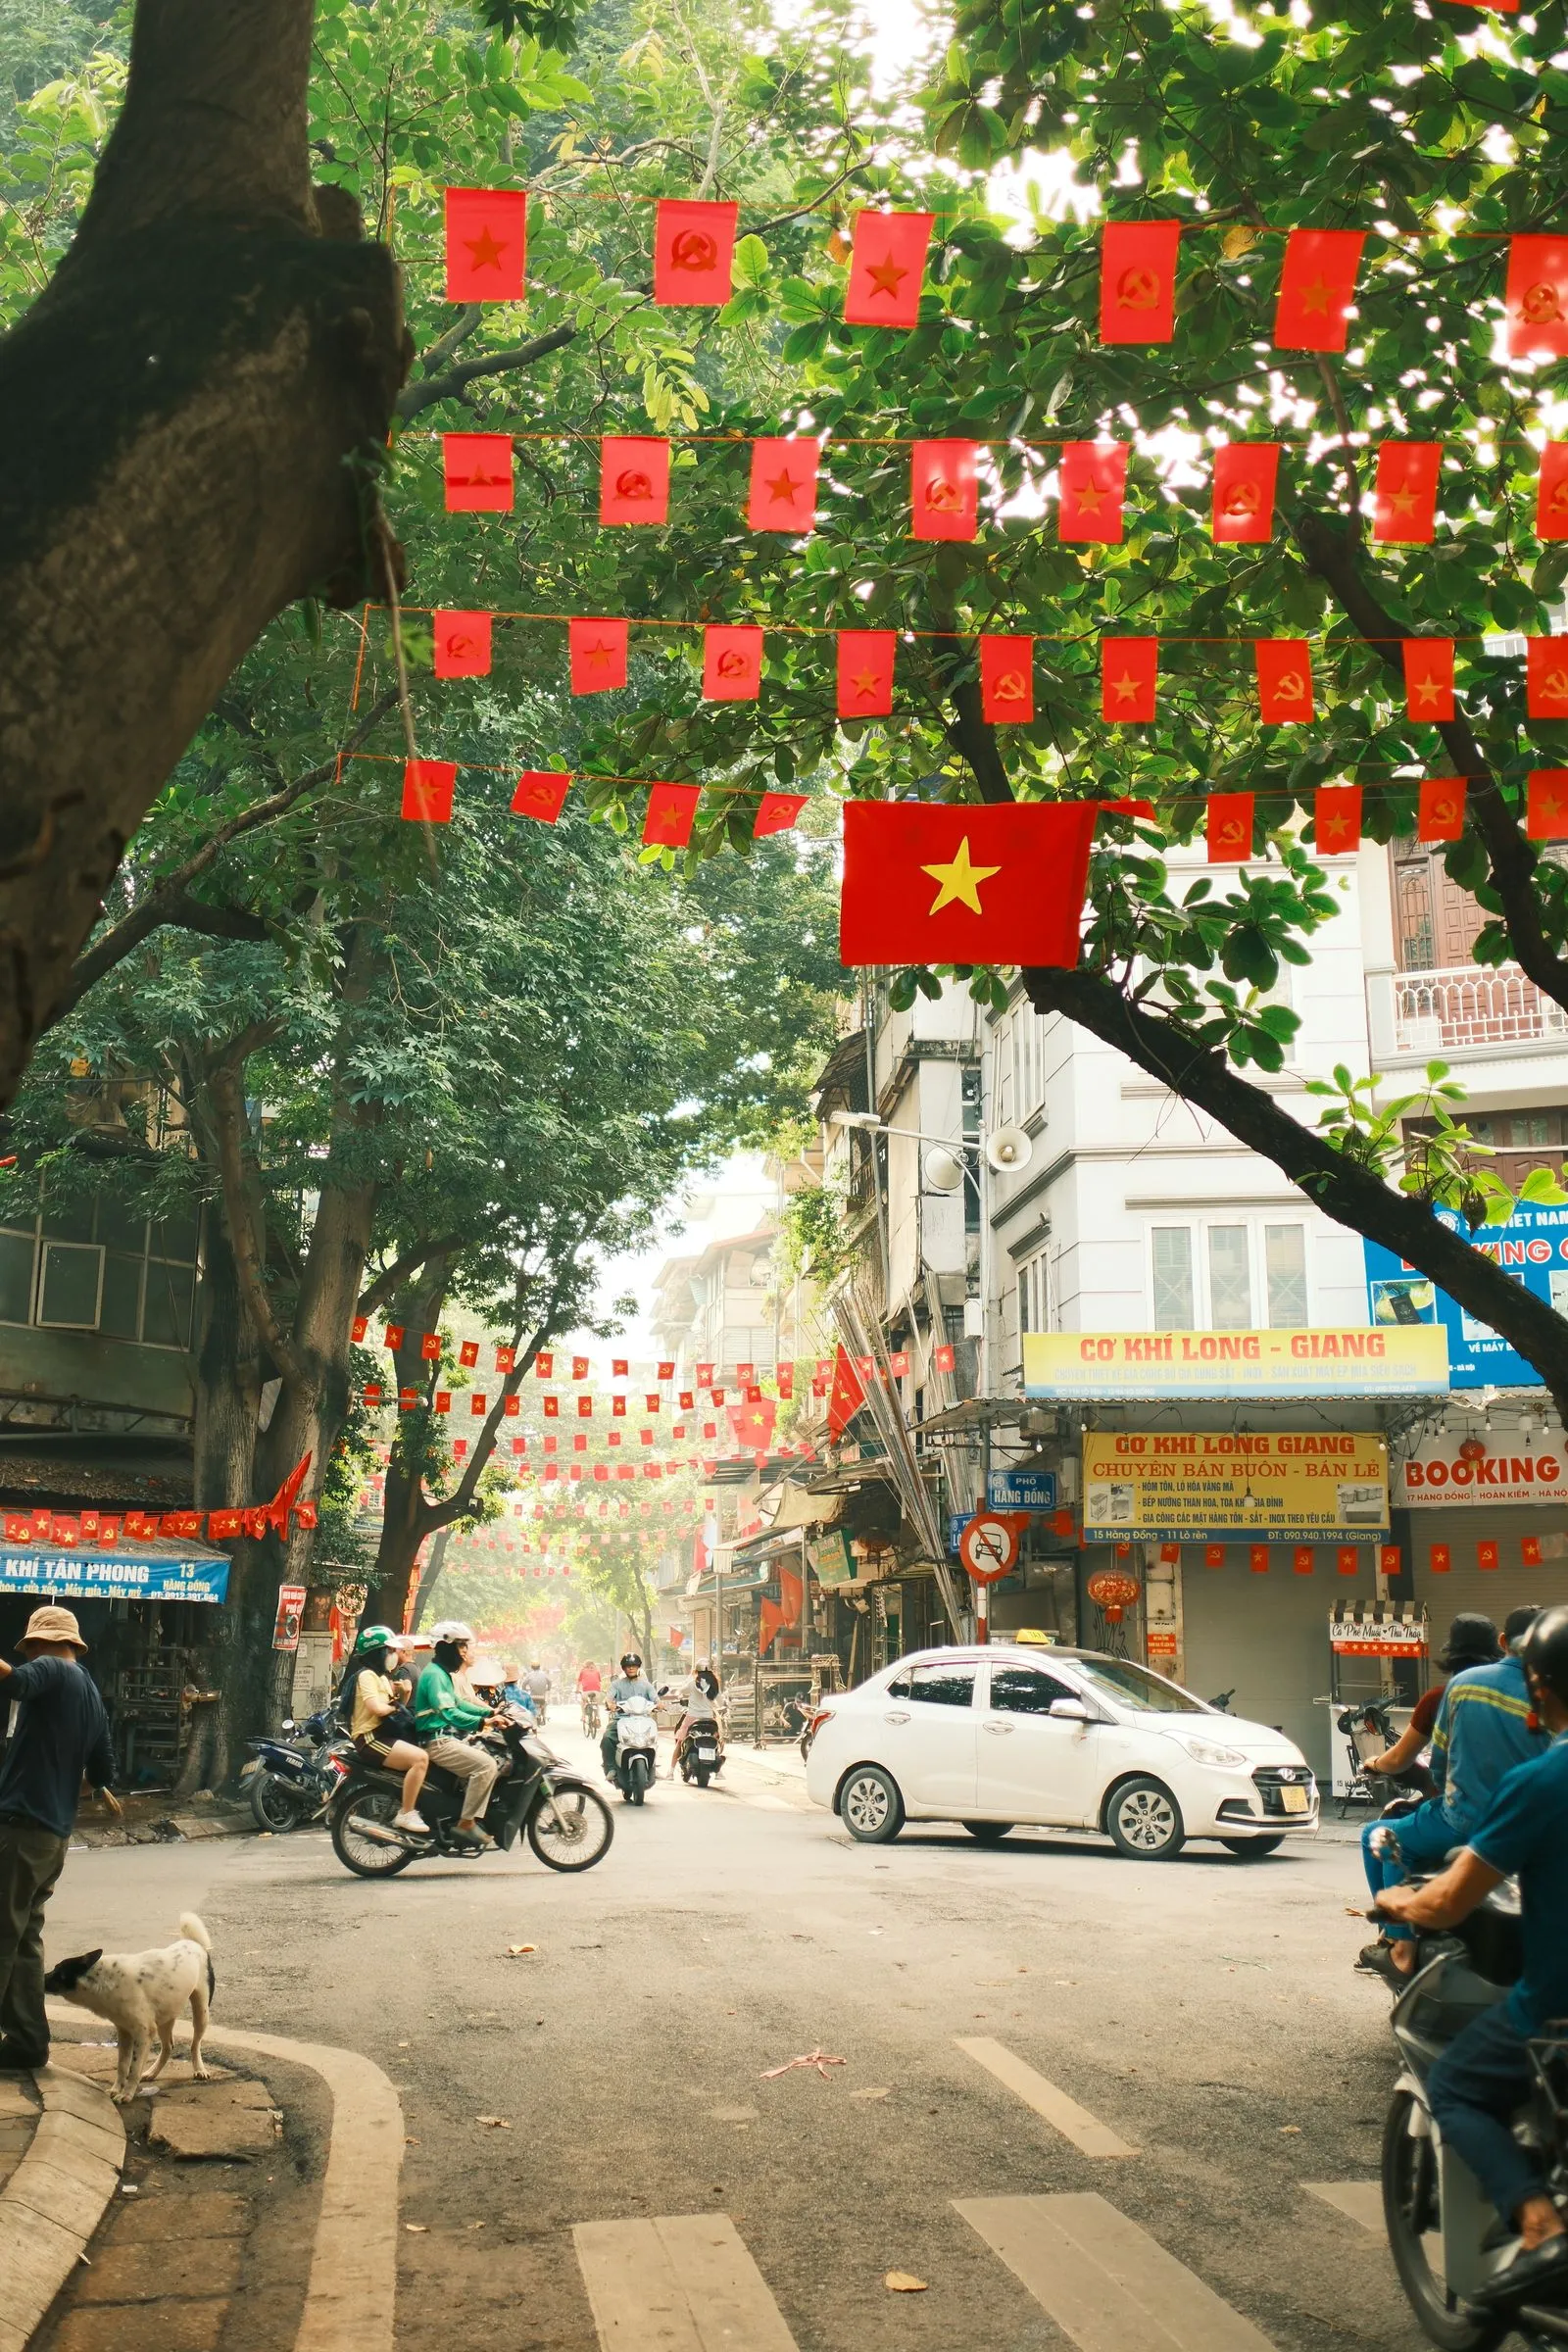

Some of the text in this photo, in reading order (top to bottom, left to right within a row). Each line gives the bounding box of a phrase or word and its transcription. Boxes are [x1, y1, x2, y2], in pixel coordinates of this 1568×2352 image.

[1080, 1339, 1117, 1361] CƠ
[1124, 1333, 1173, 1361] KHÍ
[1182, 1336, 1261, 1361] LONG
[1291, 1334, 1386, 1358] GIANG
[1115, 1437, 1149, 1454] CƠ
[1203, 1437, 1270, 1454] LONG
[1277, 1437, 1355, 1454] GIANG
[1093, 1460, 1177, 1477] CHUYÊN
[1183, 1460, 1224, 1477] BÁN
[1231, 1460, 1288, 1477] BUÔN
[1305, 1460, 1348, 1477] BÁN
[1354, 1458, 1380, 1477] LẺ
[1405, 1455, 1560, 1488] BOOKING
[1015, 1475, 1037, 1485] PHỐ
[1202, 1480, 1220, 1492] VÀNG
[994, 1487, 1051, 1504] HÀNG ĐỒNG
[1479, 1489, 1505, 1499] HOÀN
[1507, 1488, 1529, 1498] KIẾM
[1539, 1489, 1552, 1497] HÀ
[1142, 1495, 1156, 1507] BẾP
[1183, 1497, 1201, 1507] THAN
[1202, 1497, 1218, 1508] HOA,
[1220, 1497, 1233, 1507] TOA
[1143, 1513, 1153, 1523] GIA
[1155, 1511, 1176, 1523] CÔNG
[1177, 1511, 1191, 1523] CÁC
[1209, 1511, 1228, 1524] HÀNG
[1230, 1511, 1244, 1524] TÔN
[1269, 1513, 1286, 1524] INOX
[1287, 1513, 1304, 1524] THEO
[1306, 1511, 1320, 1524] YÊU
[1093, 1531, 1103, 1540] 15
[1105, 1529, 1130, 1542] Hàng
[1132, 1529, 1158, 1542] Đồng
[1167, 1531, 1176, 1540] 11
[1179, 1530, 1190, 1540] Lò
[1192, 1531, 1207, 1540] rèn
[1268, 1531, 1282, 1540] ĐT:
[1284, 1531, 1343, 1540] 090.940.1994
[1346, 1531, 1382, 1543] (Giang)
[5, 1556, 150, 1583] KHÍ TÂN PHONG
[179, 1563, 195, 1578] 13
[163, 1579, 186, 1592] HÀNG
[1388, 1625, 1402, 1638] Thu
